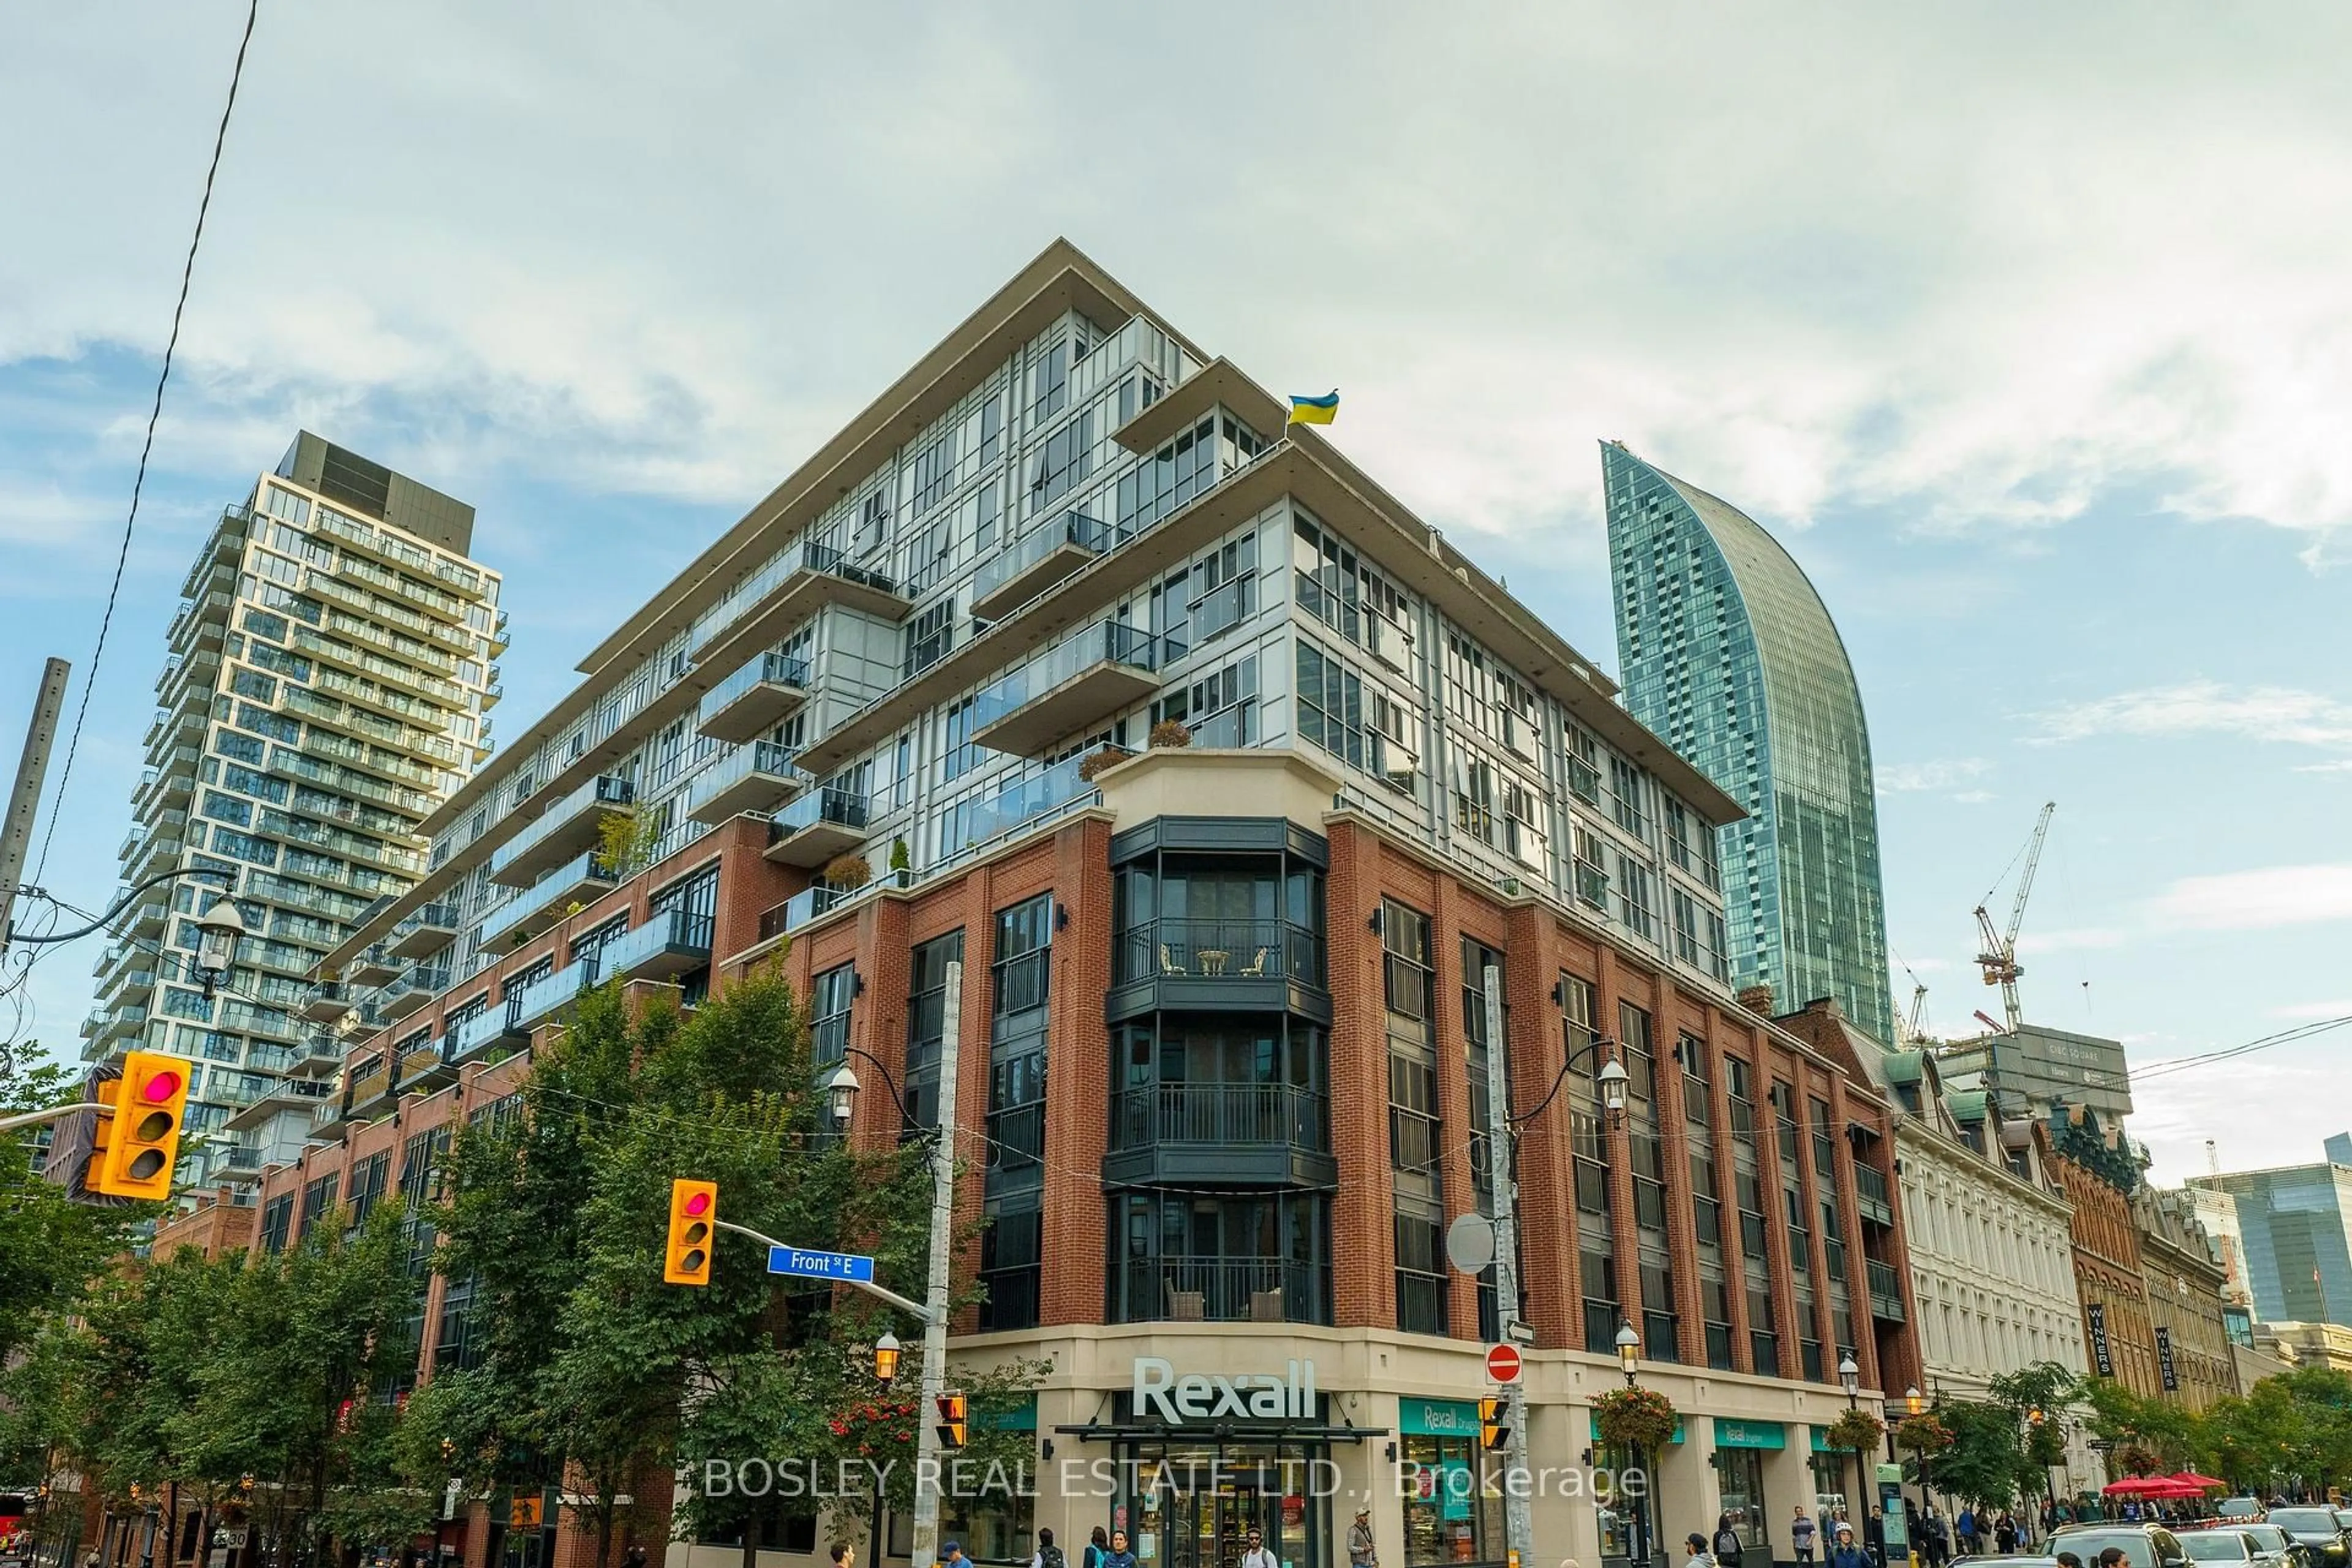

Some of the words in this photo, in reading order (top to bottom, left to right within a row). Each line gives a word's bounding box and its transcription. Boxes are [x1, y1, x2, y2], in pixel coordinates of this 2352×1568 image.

[791, 1251, 830, 1272] Front
[843, 1257, 853, 1274] E
[2089, 1309, 2109, 1373] WINNERS
[2155, 1331, 2174, 1387] WINNERS
[1133, 1357, 1316, 1424] Rexall
[1424, 1406, 1457, 1431] Rexall
[229, 1533, 246, 1545] 30
